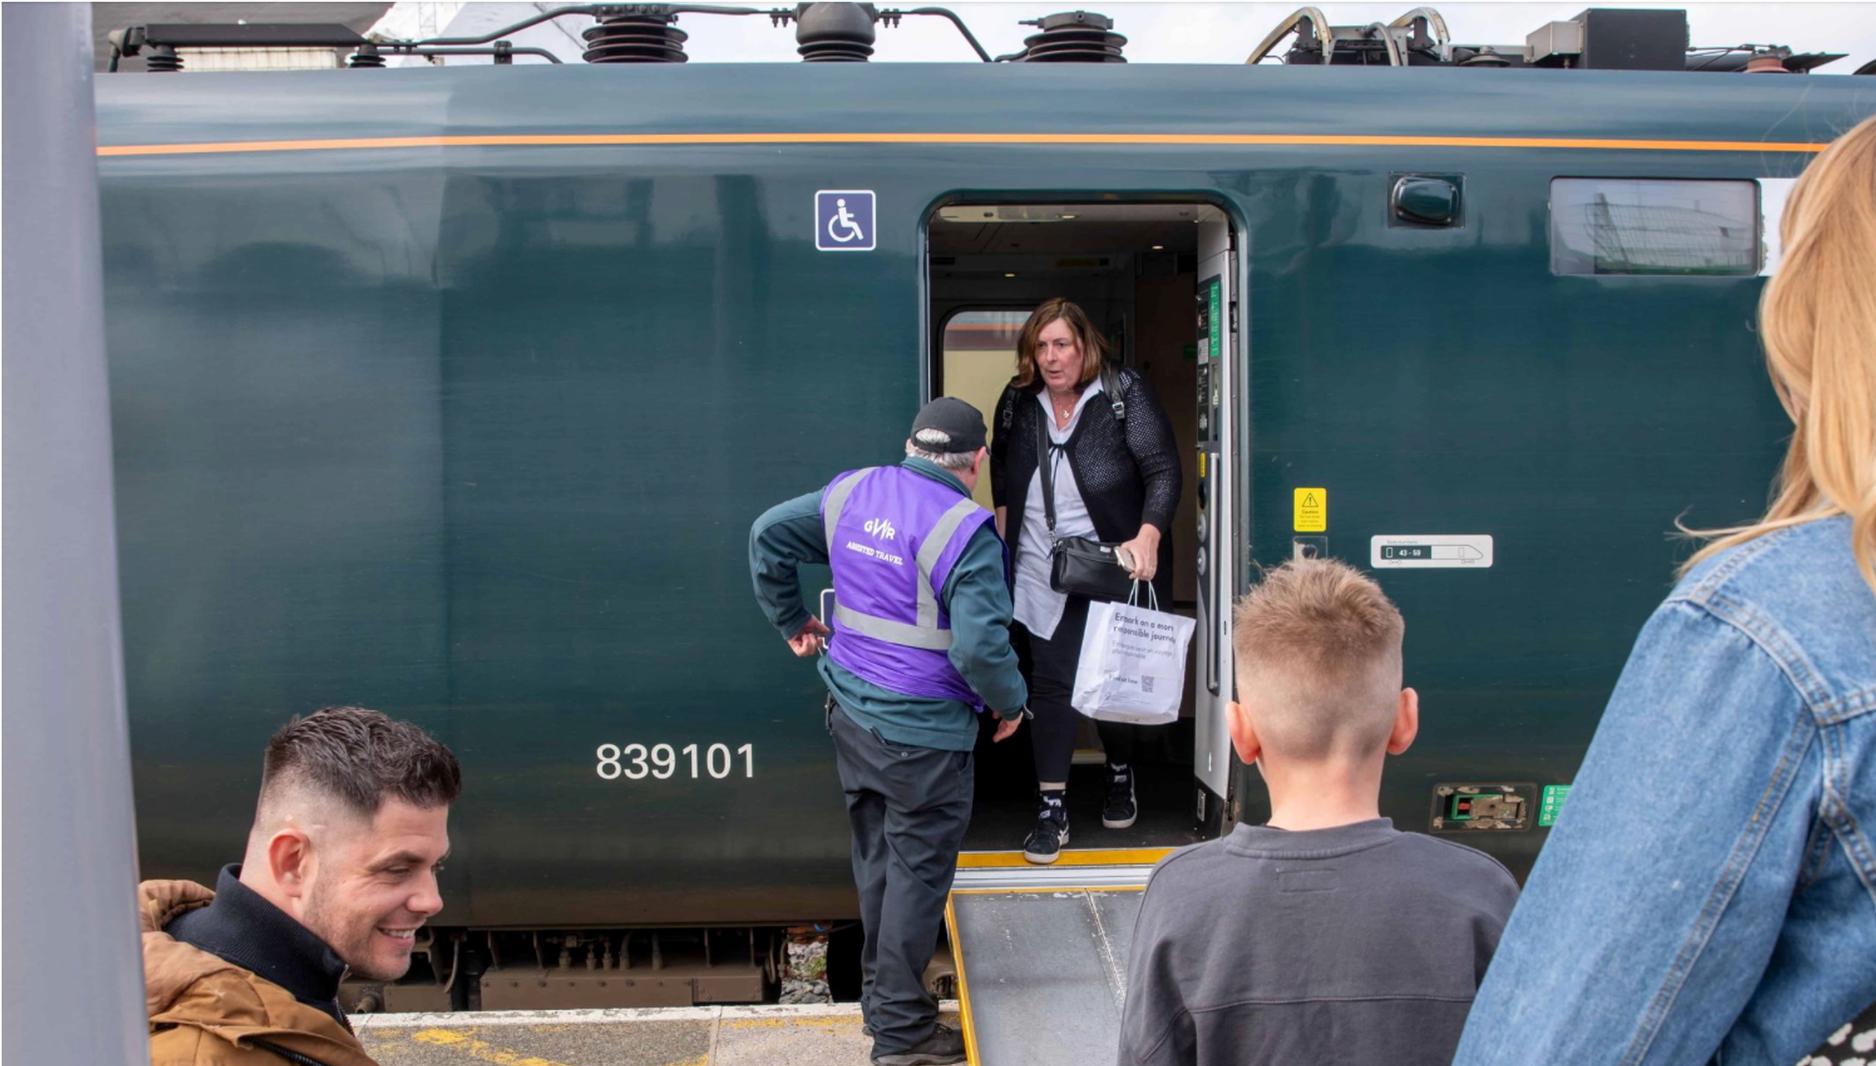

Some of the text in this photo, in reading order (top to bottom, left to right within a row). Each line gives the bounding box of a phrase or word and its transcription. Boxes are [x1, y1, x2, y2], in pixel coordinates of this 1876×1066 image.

[864, 517, 896, 540] GWR
[875, 549, 903, 566] TRAVEL
[1113, 625, 1150, 639] rsponsible
[596, 743, 753, 780] 839101
